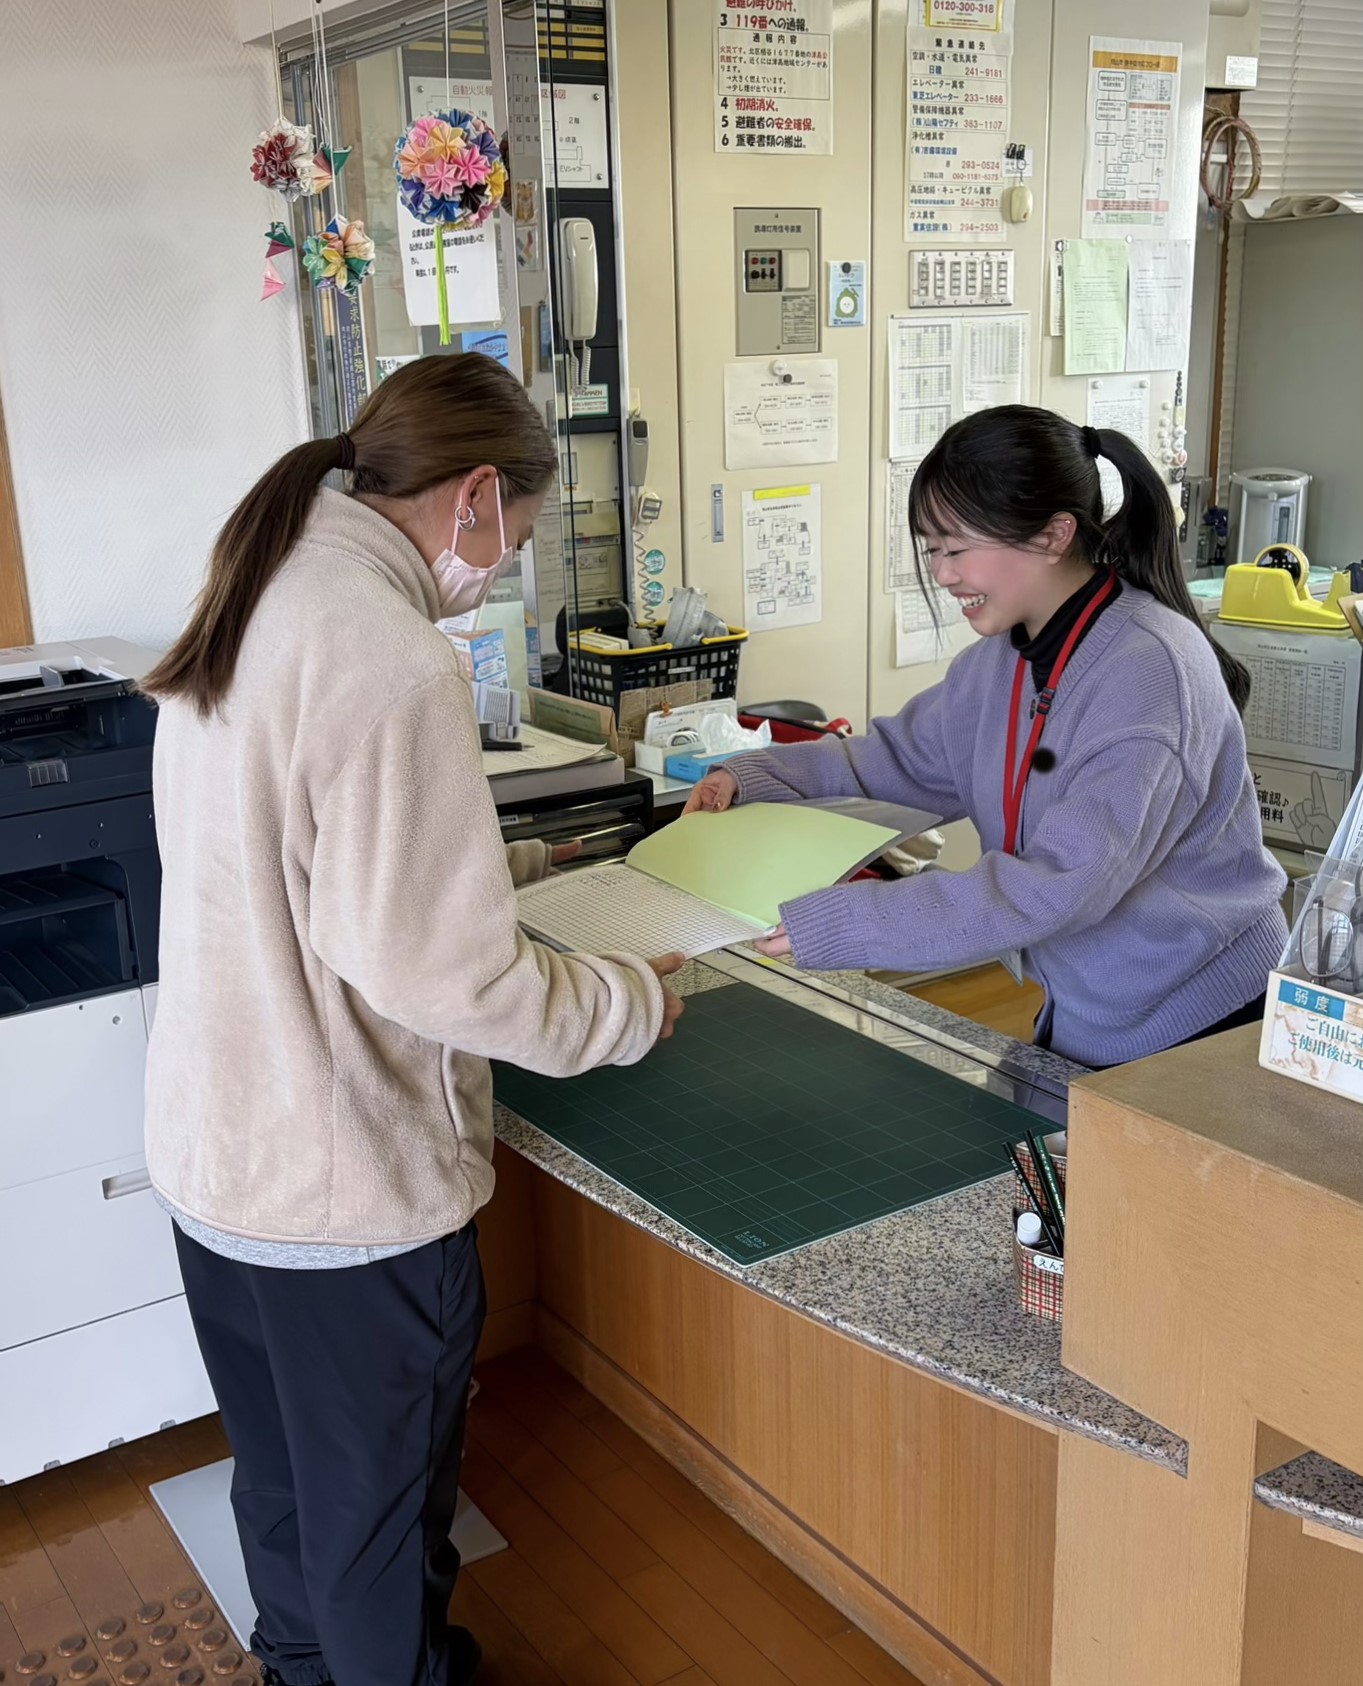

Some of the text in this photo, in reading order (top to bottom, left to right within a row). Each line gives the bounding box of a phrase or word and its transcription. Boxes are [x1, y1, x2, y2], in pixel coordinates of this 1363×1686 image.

[933, 0, 994, 13] 0120-300-318
[720, 14, 809, 32] 3 119番への通報。
[720, 97, 779, 112] 4 初期消火。
[721, 115, 815, 131] 5 避難者の安全確保。
[721, 134, 729, 146] 6
